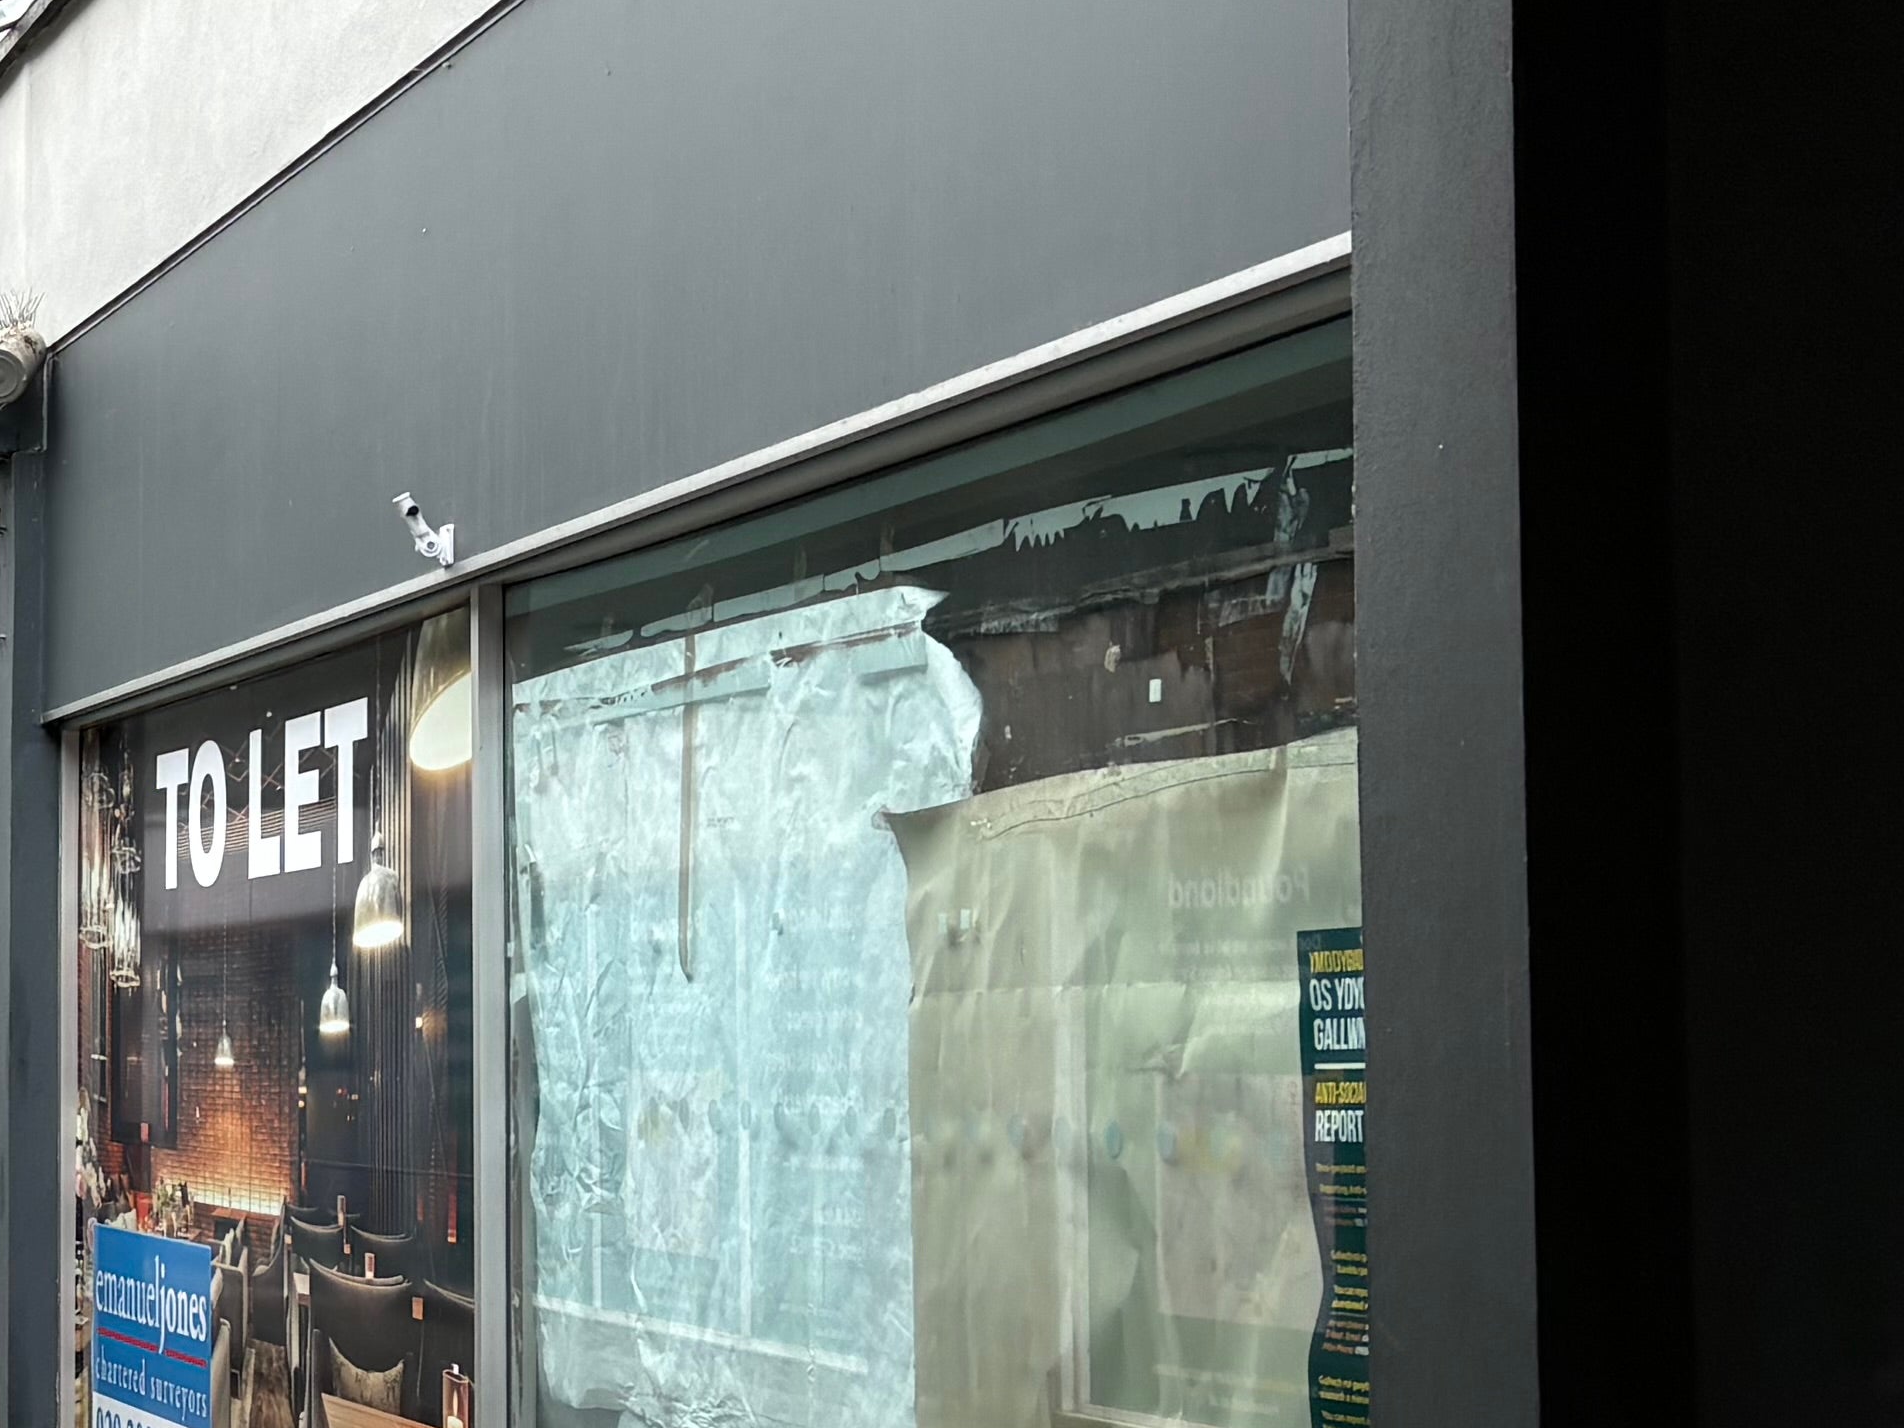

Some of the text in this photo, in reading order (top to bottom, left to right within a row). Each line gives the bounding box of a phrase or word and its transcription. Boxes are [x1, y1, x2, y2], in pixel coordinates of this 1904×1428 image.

[156, 696, 370, 890] TO LET
[1309, 977, 1332, 1012] OS
[1314, 1109, 1365, 1143] REPORT
[95, 1344, 208, 1421] chartered surveyors
